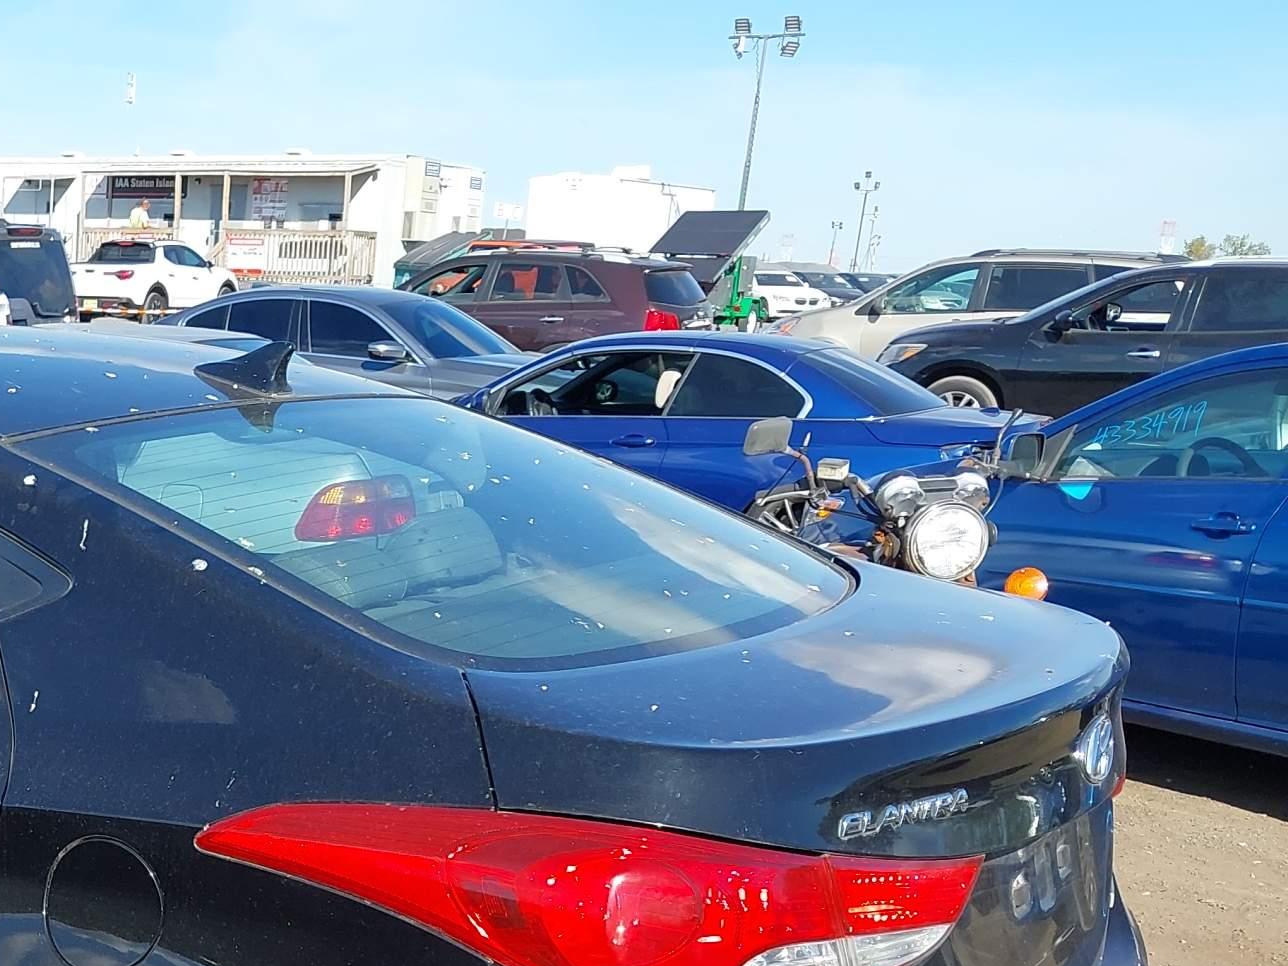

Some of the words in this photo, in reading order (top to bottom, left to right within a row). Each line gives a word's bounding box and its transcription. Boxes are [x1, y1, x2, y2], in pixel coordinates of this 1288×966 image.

[115, 178, 130, 187] IAA
[131, 178, 154, 187] Staten
[155, 178, 175, 187] Islan
[1094, 401, 1208, 443] 43334919
[838, 788, 969, 840] ELANTRA
